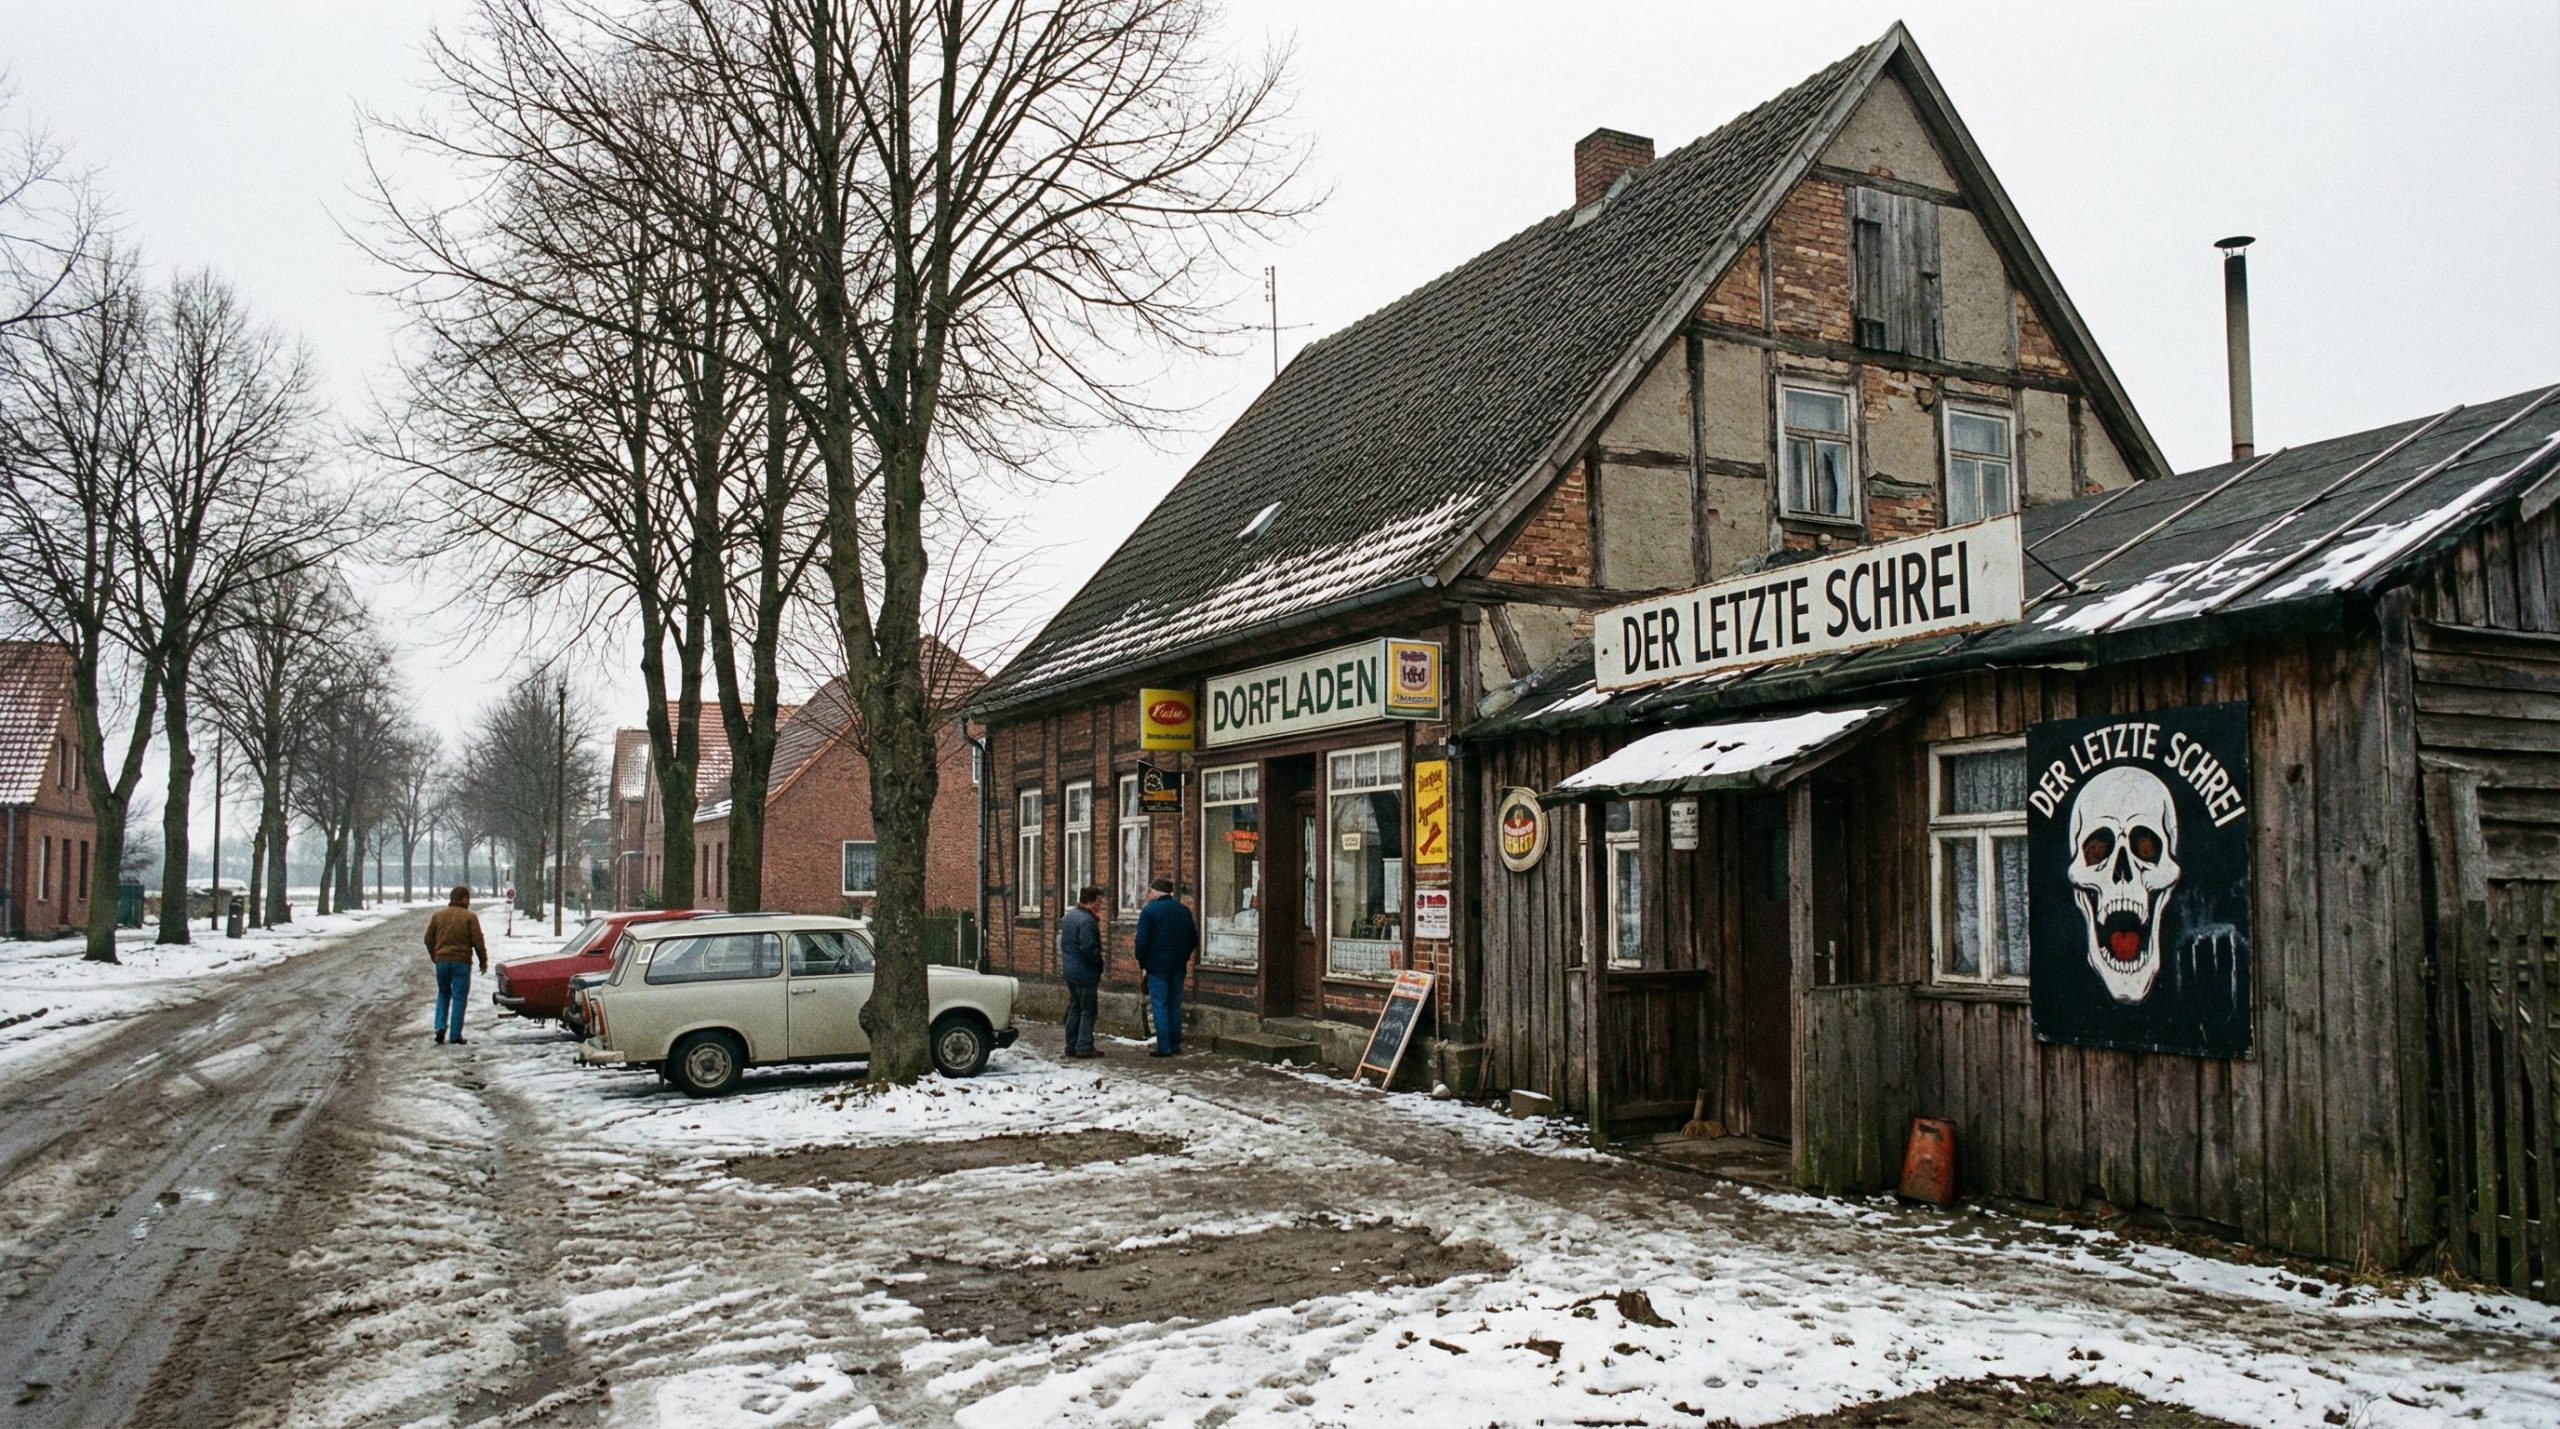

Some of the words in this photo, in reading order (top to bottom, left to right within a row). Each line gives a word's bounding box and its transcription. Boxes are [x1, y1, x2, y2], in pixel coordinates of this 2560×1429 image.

[1623, 607, 1681, 675] DER
[1694, 577, 1810, 663] LETZTE
[1826, 541, 1971, 638] SCHREI
[1214, 656, 1377, 732] DORFLADEN
[2029, 760, 2075, 819] DER
[2070, 722, 2160, 774] LETZTE
[2164, 732, 2246, 828] SCHREI
